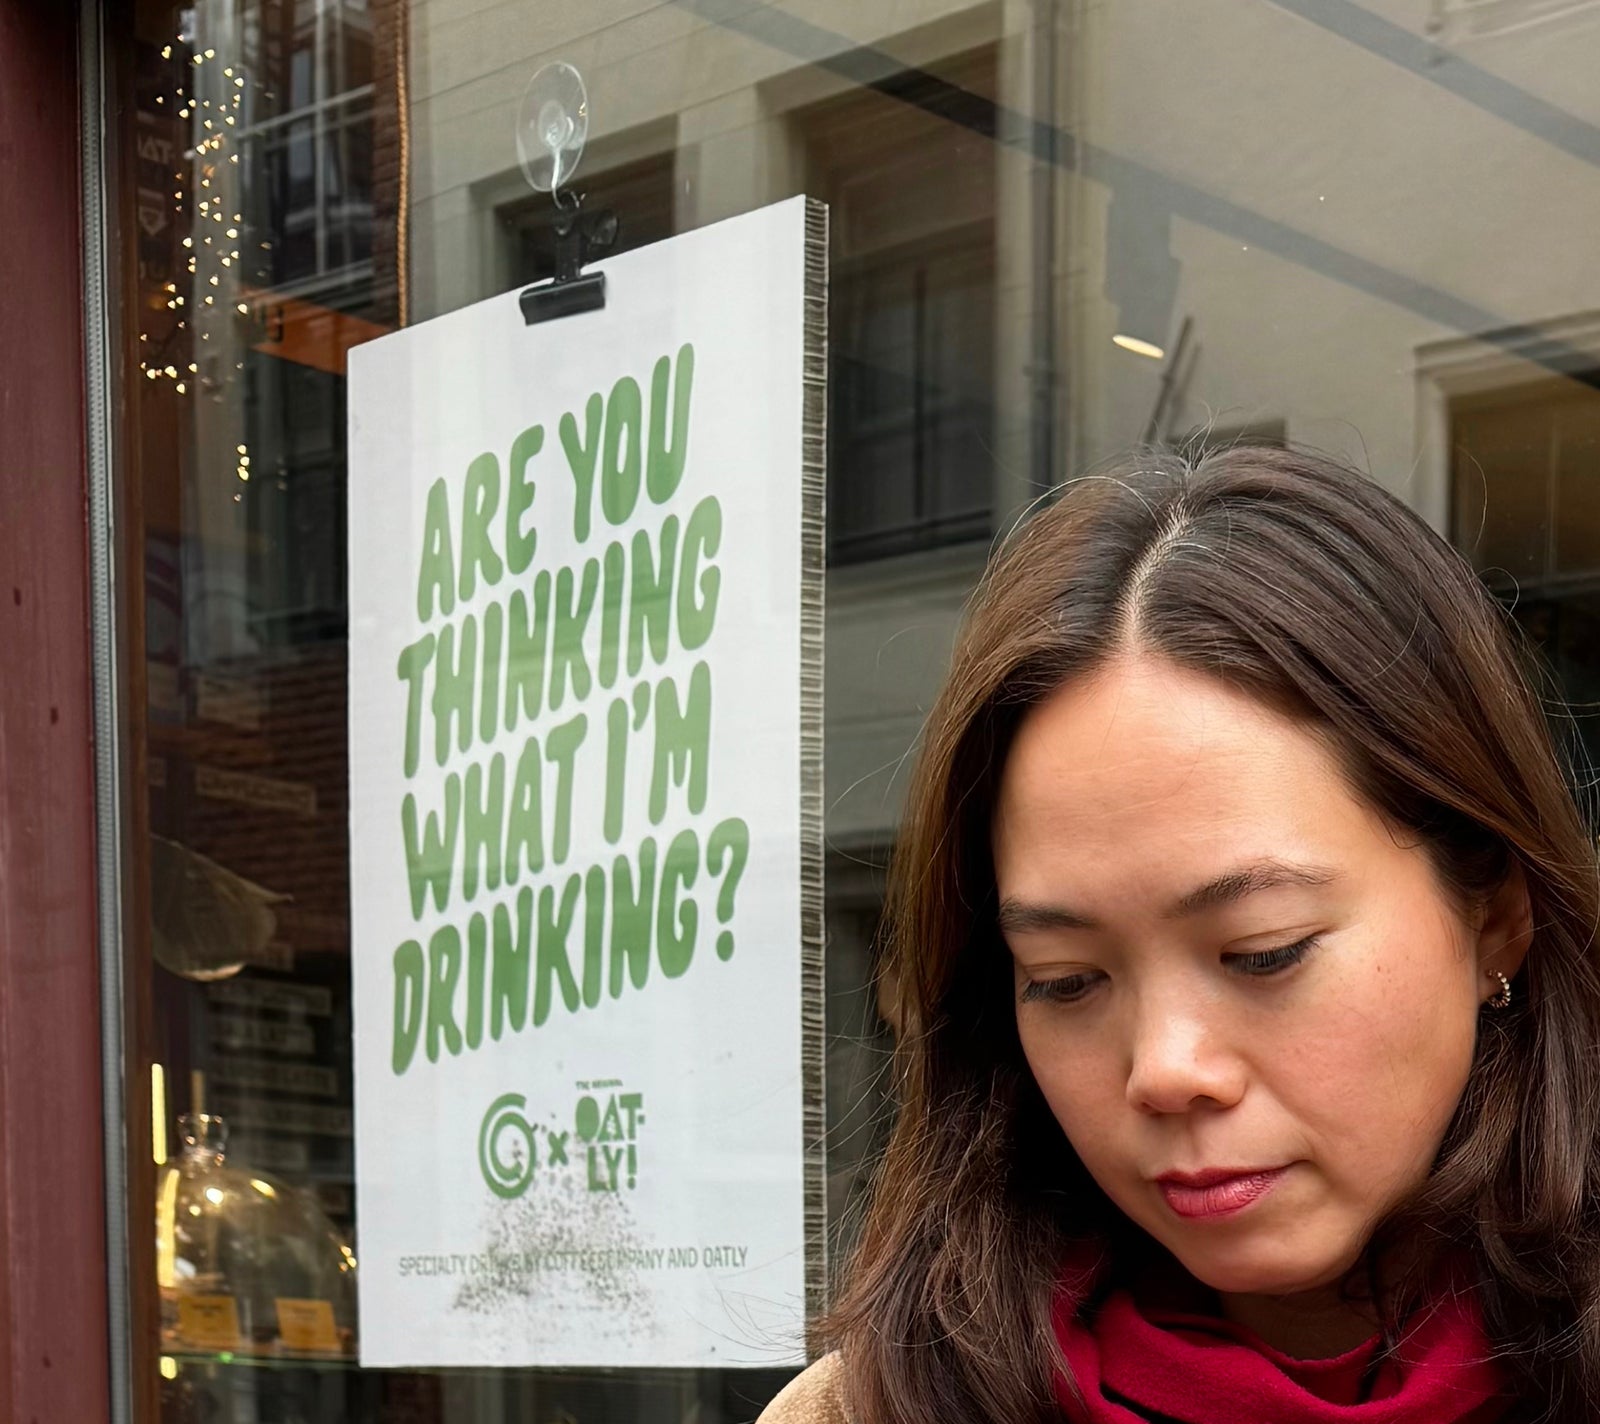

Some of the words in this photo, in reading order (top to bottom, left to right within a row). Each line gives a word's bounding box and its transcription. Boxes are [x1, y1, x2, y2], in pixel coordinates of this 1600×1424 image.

[418, 425, 545, 622] ARE
[559, 343, 694, 544] YOU
[398, 495, 722, 779] THINKING
[402, 712, 588, 921] WHAT
[603, 661, 712, 844] I'M
[392, 817, 750, 1075] DRINKING?
[399, 1254, 467, 1277] SPECIALTY
[667, 1246, 699, 1269] AND
[702, 1245, 749, 1269] OATLY
